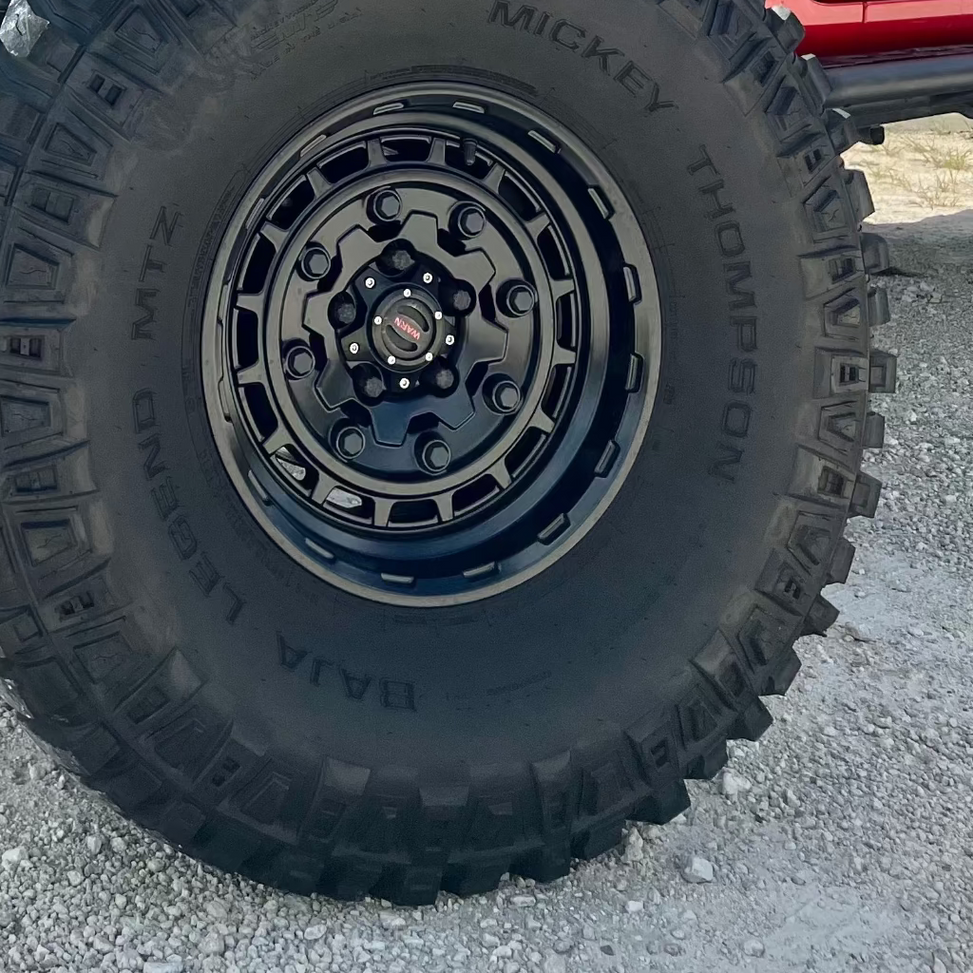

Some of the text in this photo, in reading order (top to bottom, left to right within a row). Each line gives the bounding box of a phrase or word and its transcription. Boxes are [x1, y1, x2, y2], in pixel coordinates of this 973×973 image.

[394, 317, 421, 340] WARN
[686, 143, 759, 484] THOMPSON
[132, 387, 247, 625] LEGEND
[277, 629, 417, 713] BAJA
